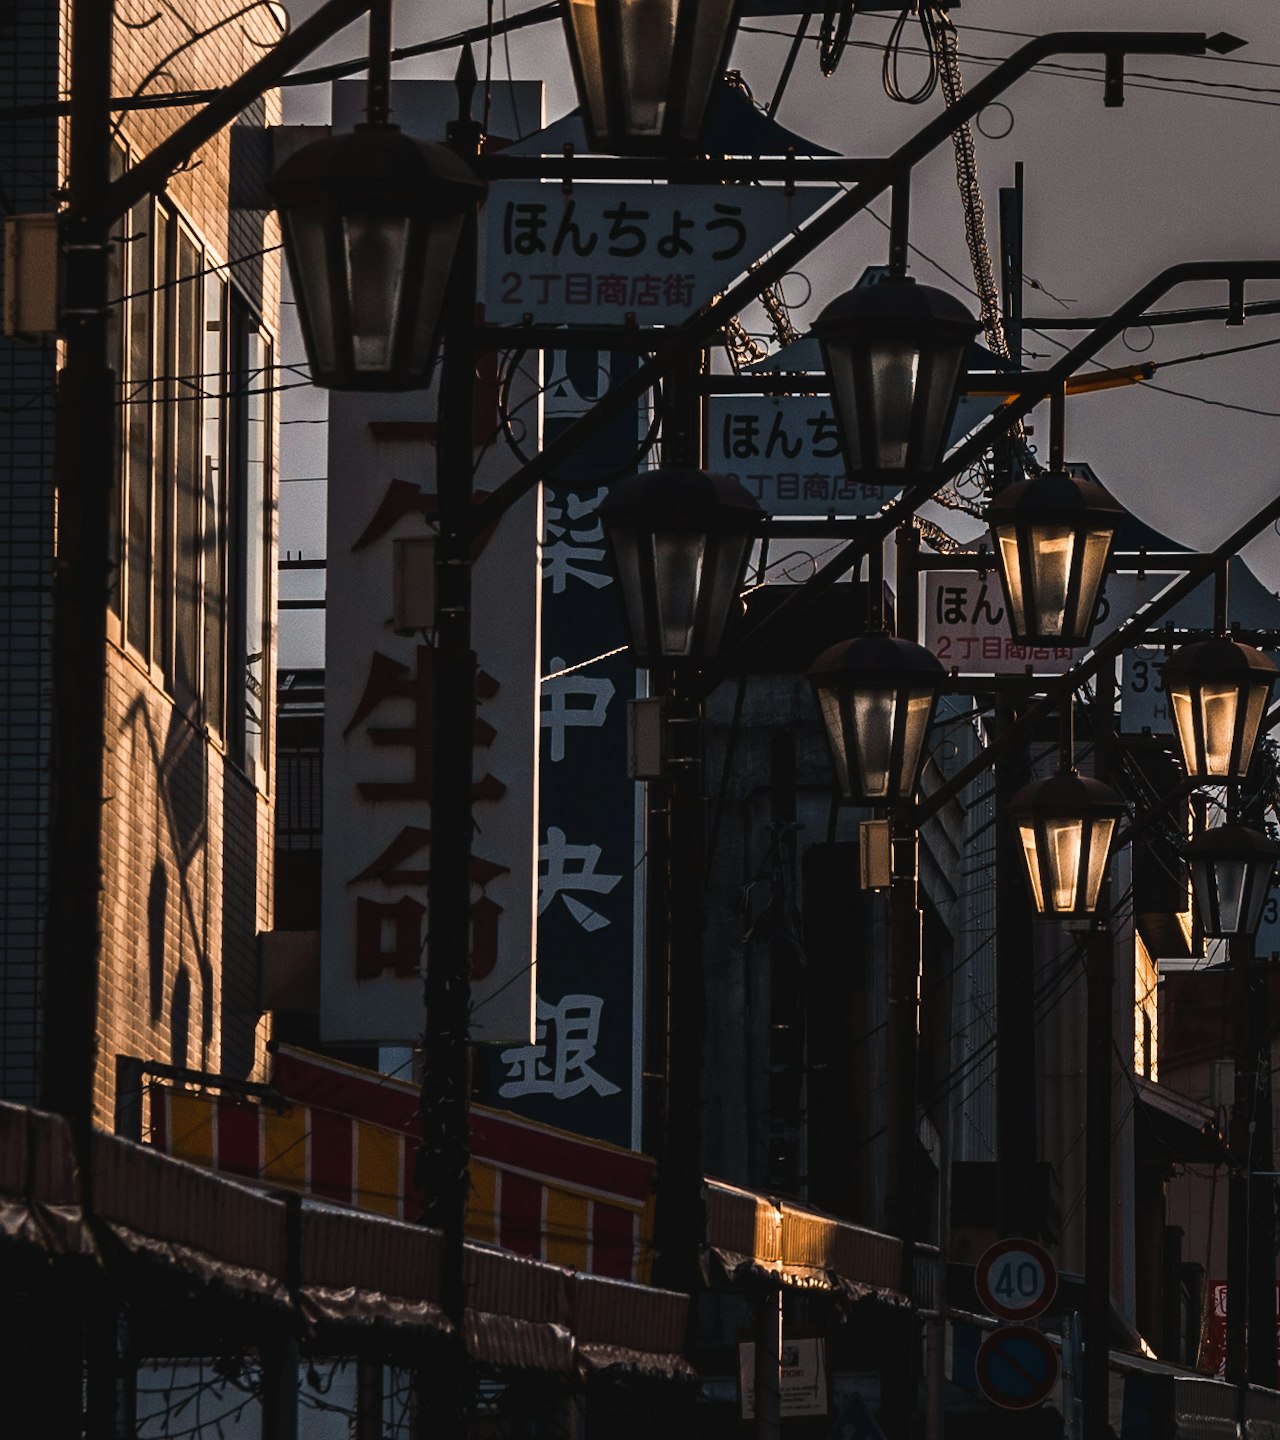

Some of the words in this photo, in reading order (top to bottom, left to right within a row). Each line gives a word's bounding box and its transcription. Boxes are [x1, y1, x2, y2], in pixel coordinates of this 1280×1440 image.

[503, 200, 748, 261] ほんちょう
[501, 271, 696, 308] 2丁目商店街
[723, 410, 842, 459] ほんち
[994, 1262, 1040, 1298] 40
